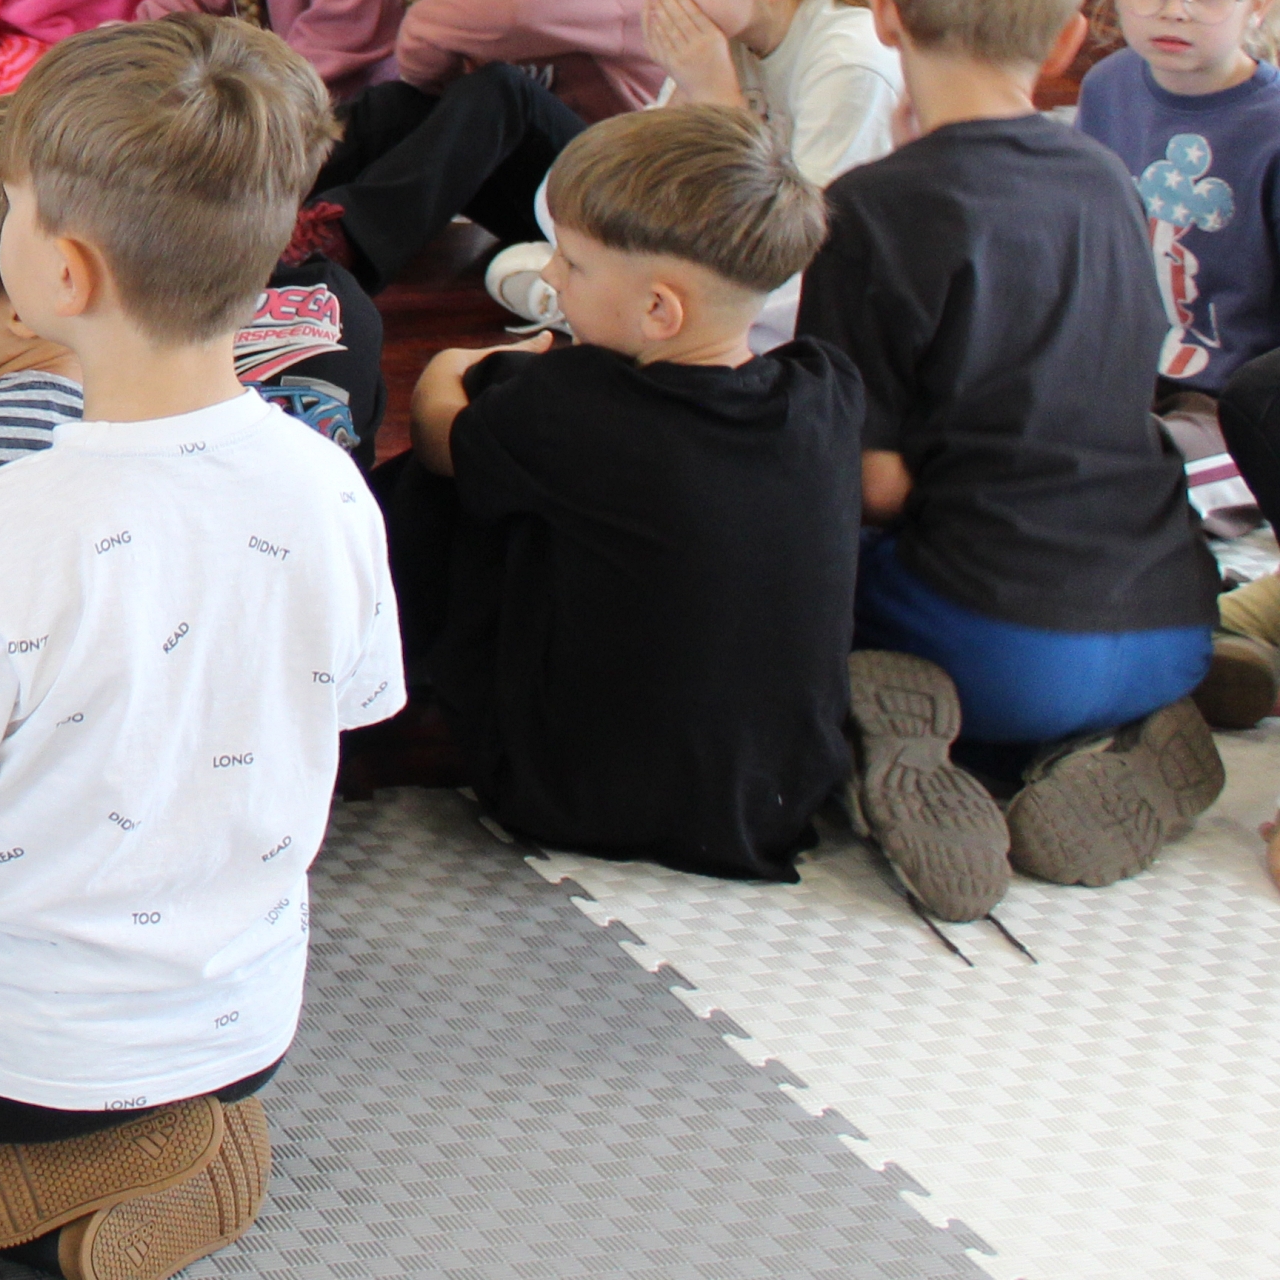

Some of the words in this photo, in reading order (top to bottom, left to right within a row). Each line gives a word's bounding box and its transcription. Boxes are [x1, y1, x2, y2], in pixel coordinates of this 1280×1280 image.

[94, 530, 132, 555] LONG
[247, 535, 291, 561] DIDN'T
[162, 621, 190, 654] READ
[360, 681, 389, 709] READ
[213, 752, 255, 769] LONG
[261, 835, 292, 862] READ
[132, 911, 162, 926] TOO
[264, 898, 290, 925] LONG
[214, 1011, 240, 1029] TOO
[104, 1096, 147, 1111] LONG
